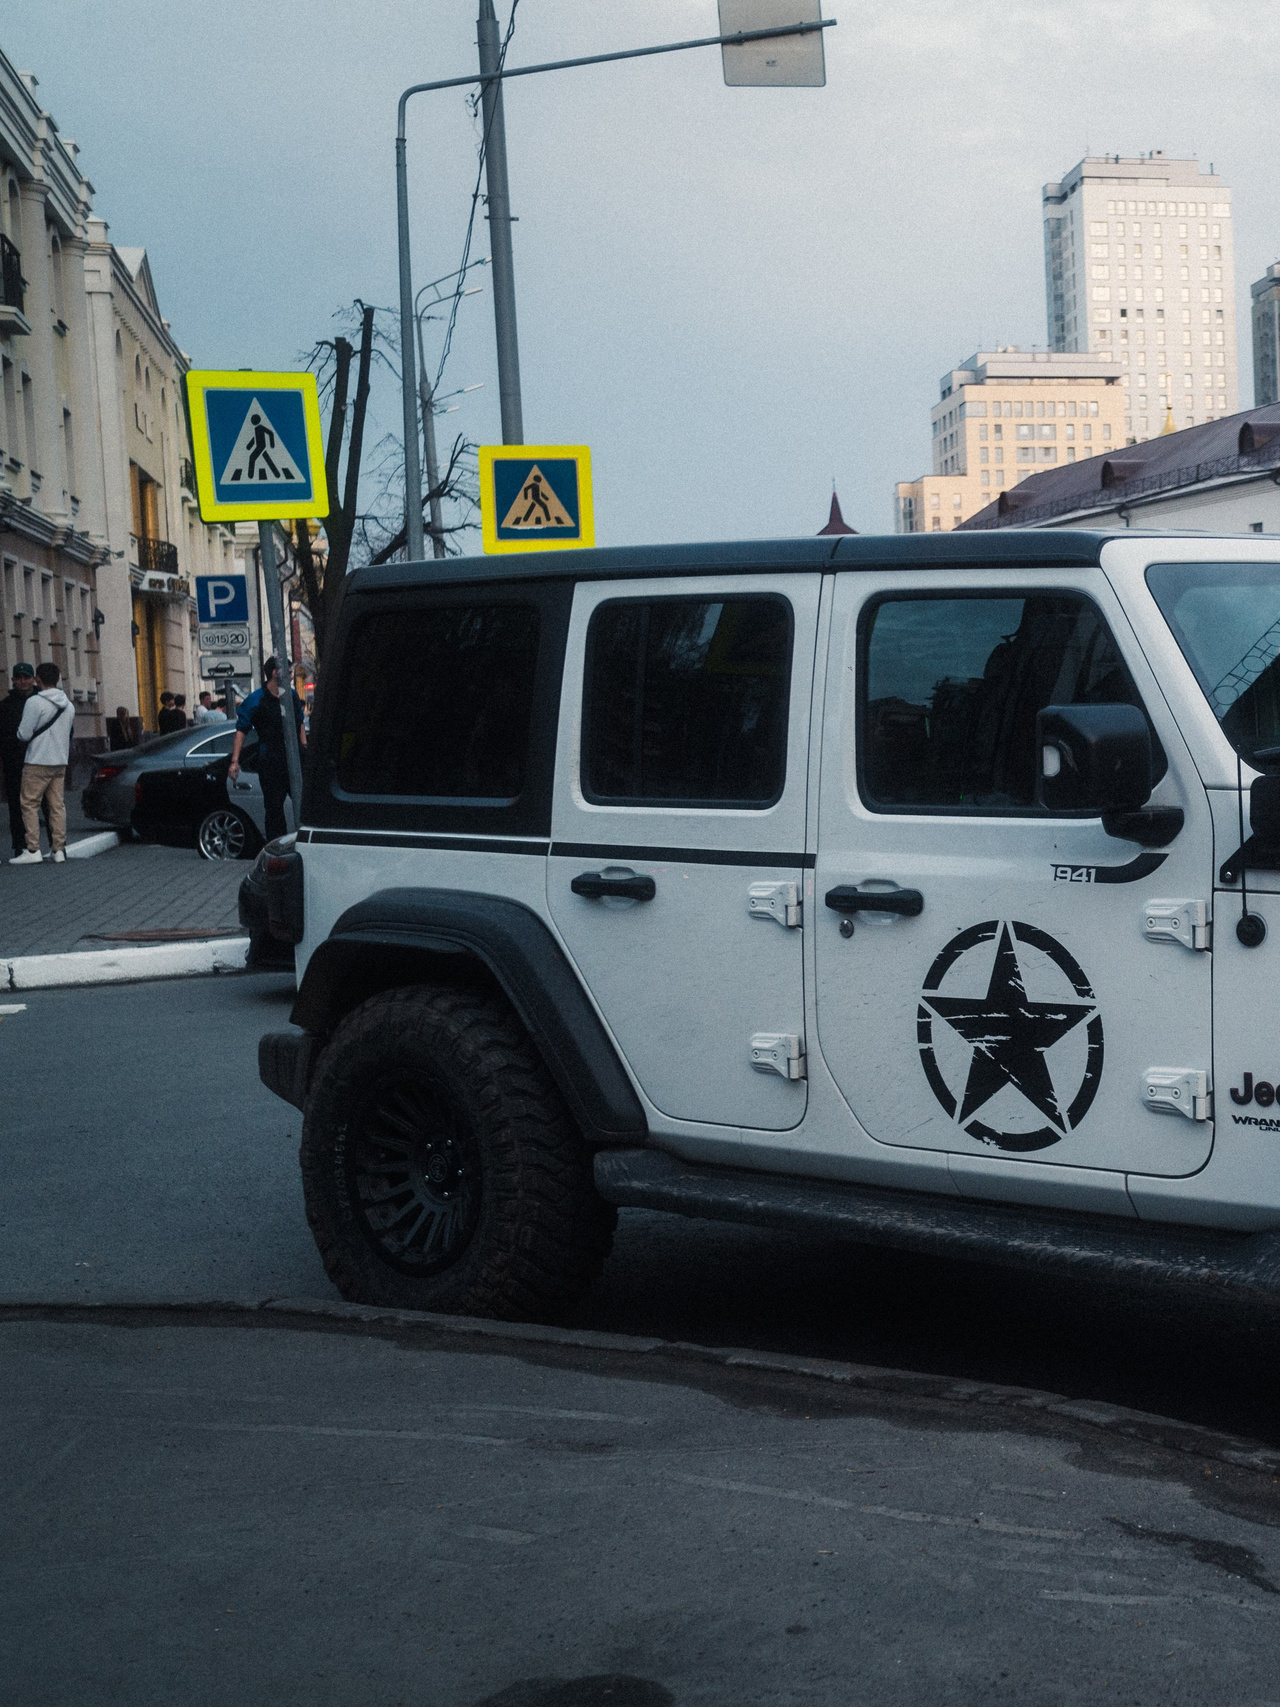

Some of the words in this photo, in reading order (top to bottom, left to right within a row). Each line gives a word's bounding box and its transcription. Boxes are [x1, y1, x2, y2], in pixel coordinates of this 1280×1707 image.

[207, 580, 236, 618] P
[205, 635, 215, 644] 10
[216, 634, 226, 644] 15
[230, 632, 245, 645] 20
